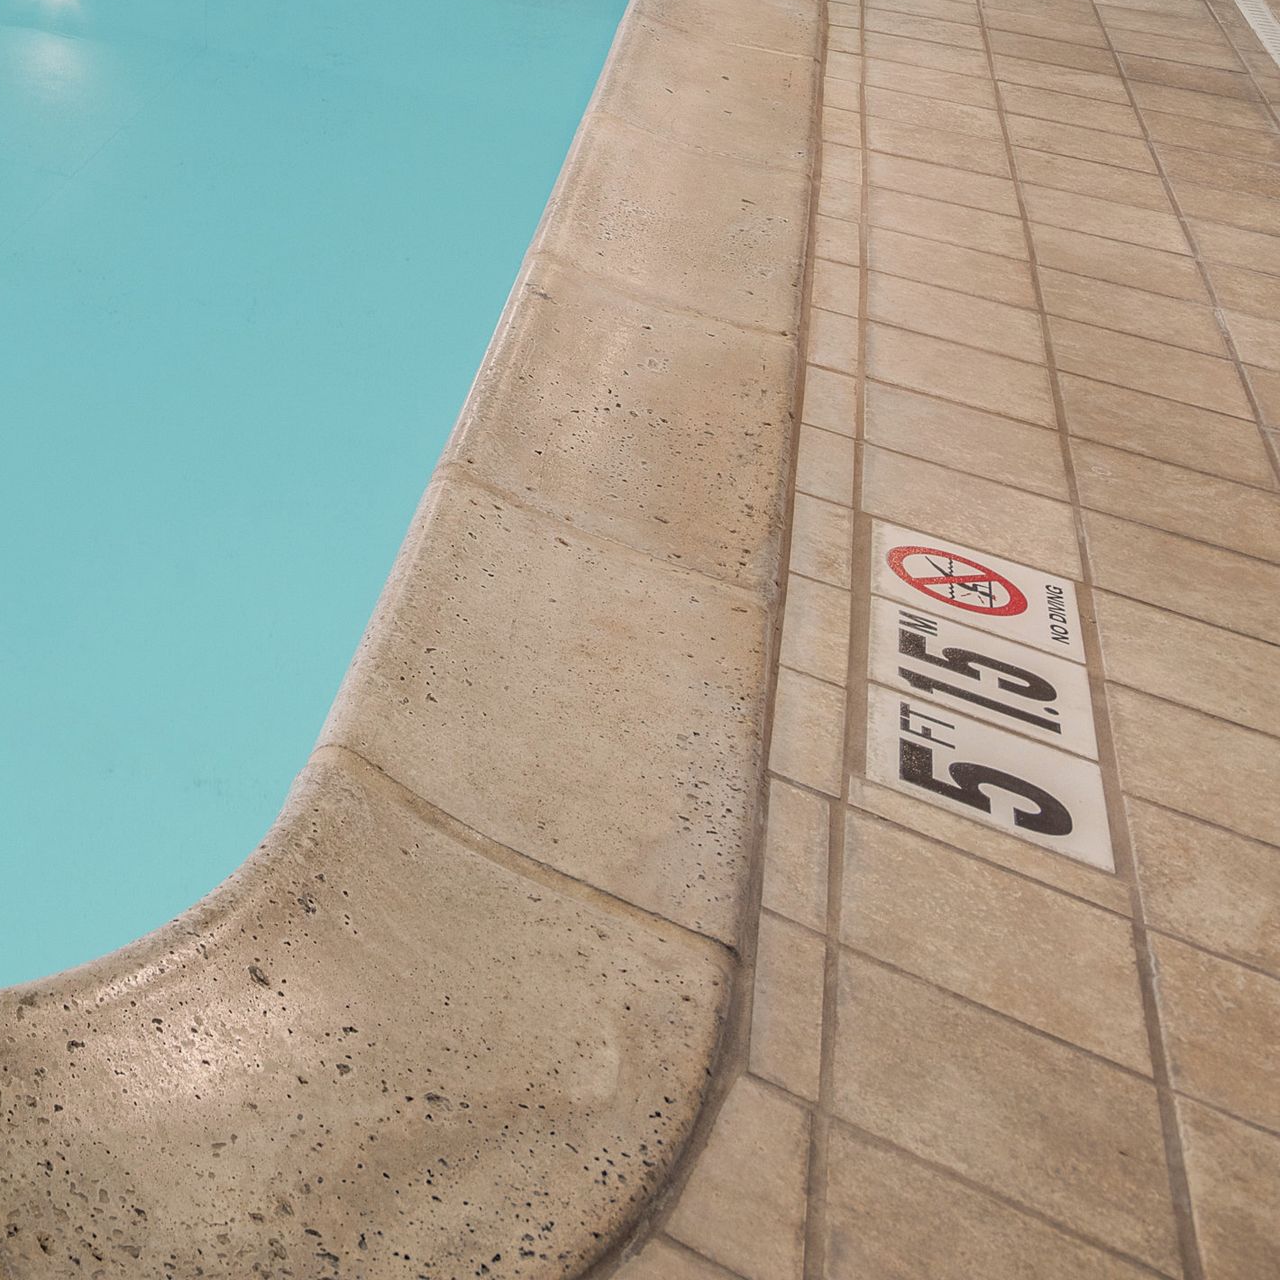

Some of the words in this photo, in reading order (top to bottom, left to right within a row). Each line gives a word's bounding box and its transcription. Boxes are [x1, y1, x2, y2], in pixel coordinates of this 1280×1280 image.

[1045, 584, 1067, 624] DIVING
[1050, 624, 1070, 645] NO
[898, 627, 1062, 735] 1.5
[900, 701, 956, 750] FT
[899, 737, 1073, 836] 5
